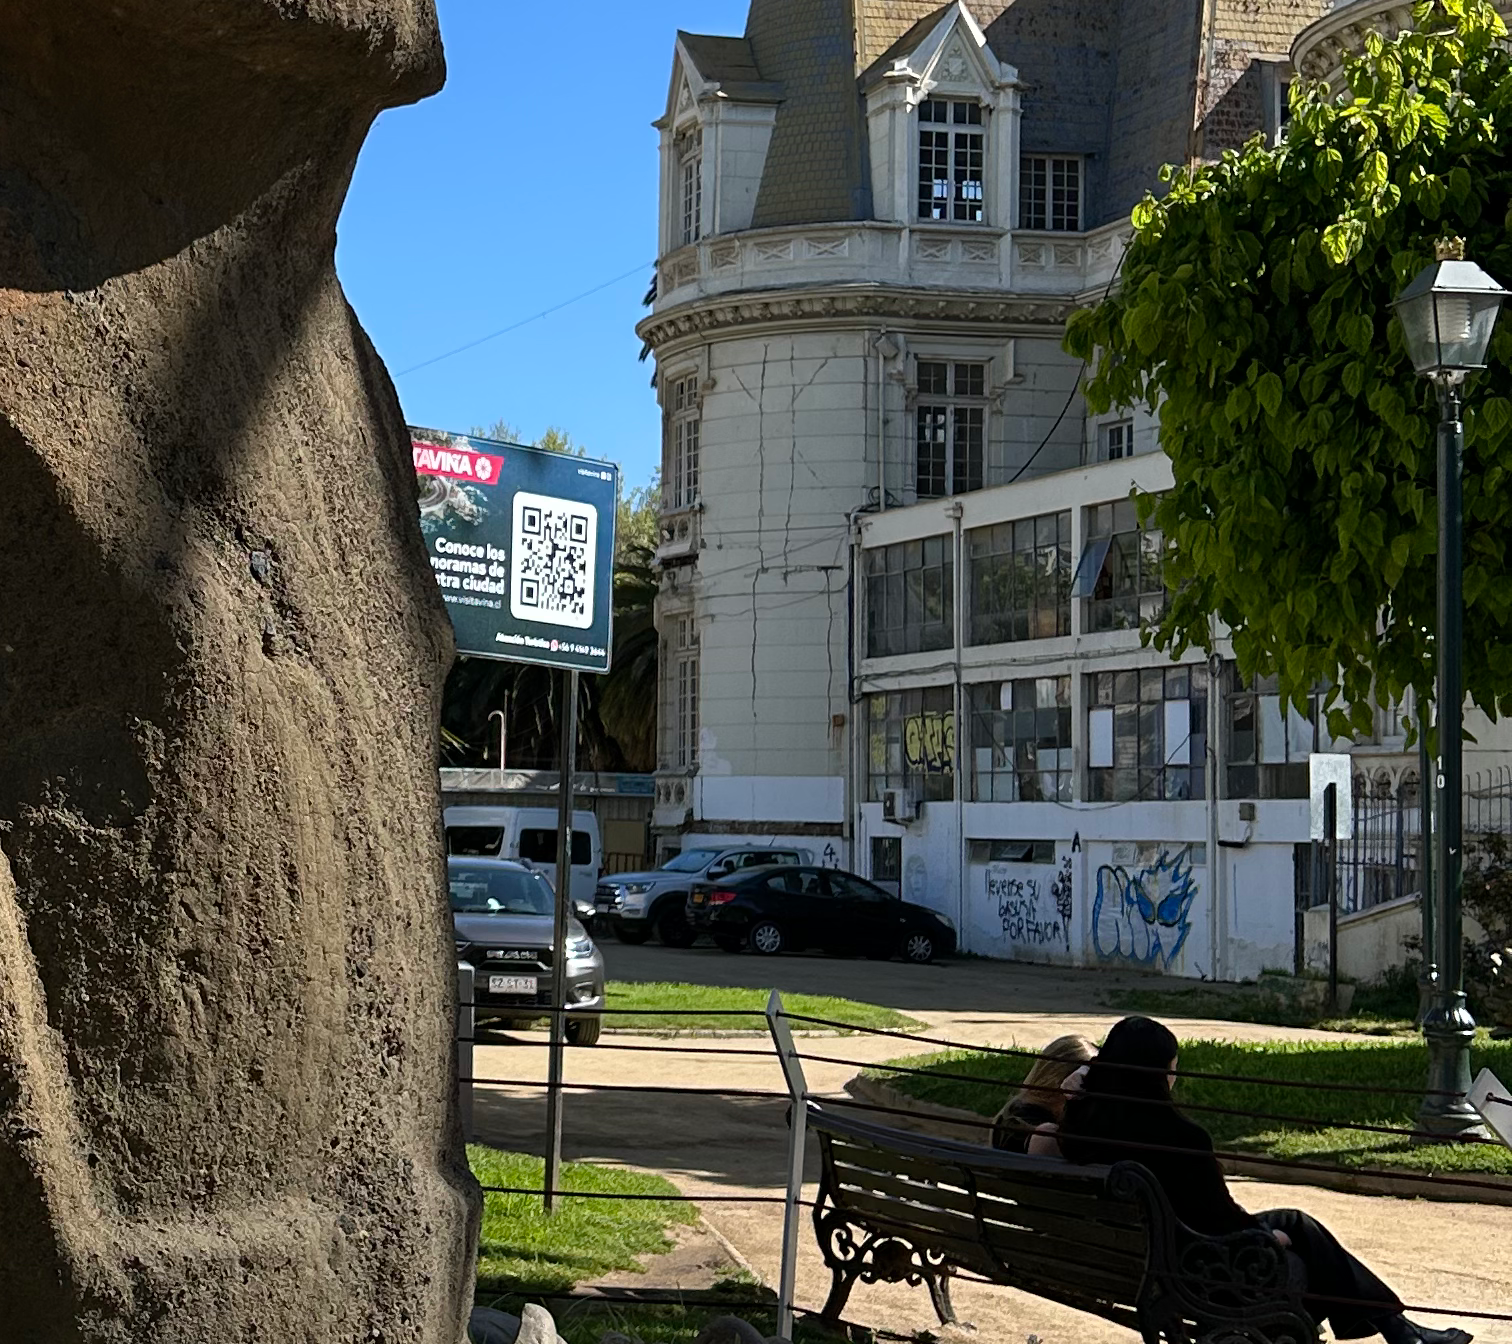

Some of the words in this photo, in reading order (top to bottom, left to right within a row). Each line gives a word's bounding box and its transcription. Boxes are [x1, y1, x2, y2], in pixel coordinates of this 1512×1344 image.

[435, 537, 484, 558] Conoce
[487, 543, 505, 561] los
[489, 561, 505, 577] de
[462, 575, 505, 595] ciudad
[1003, 917, 1026, 944] POR
